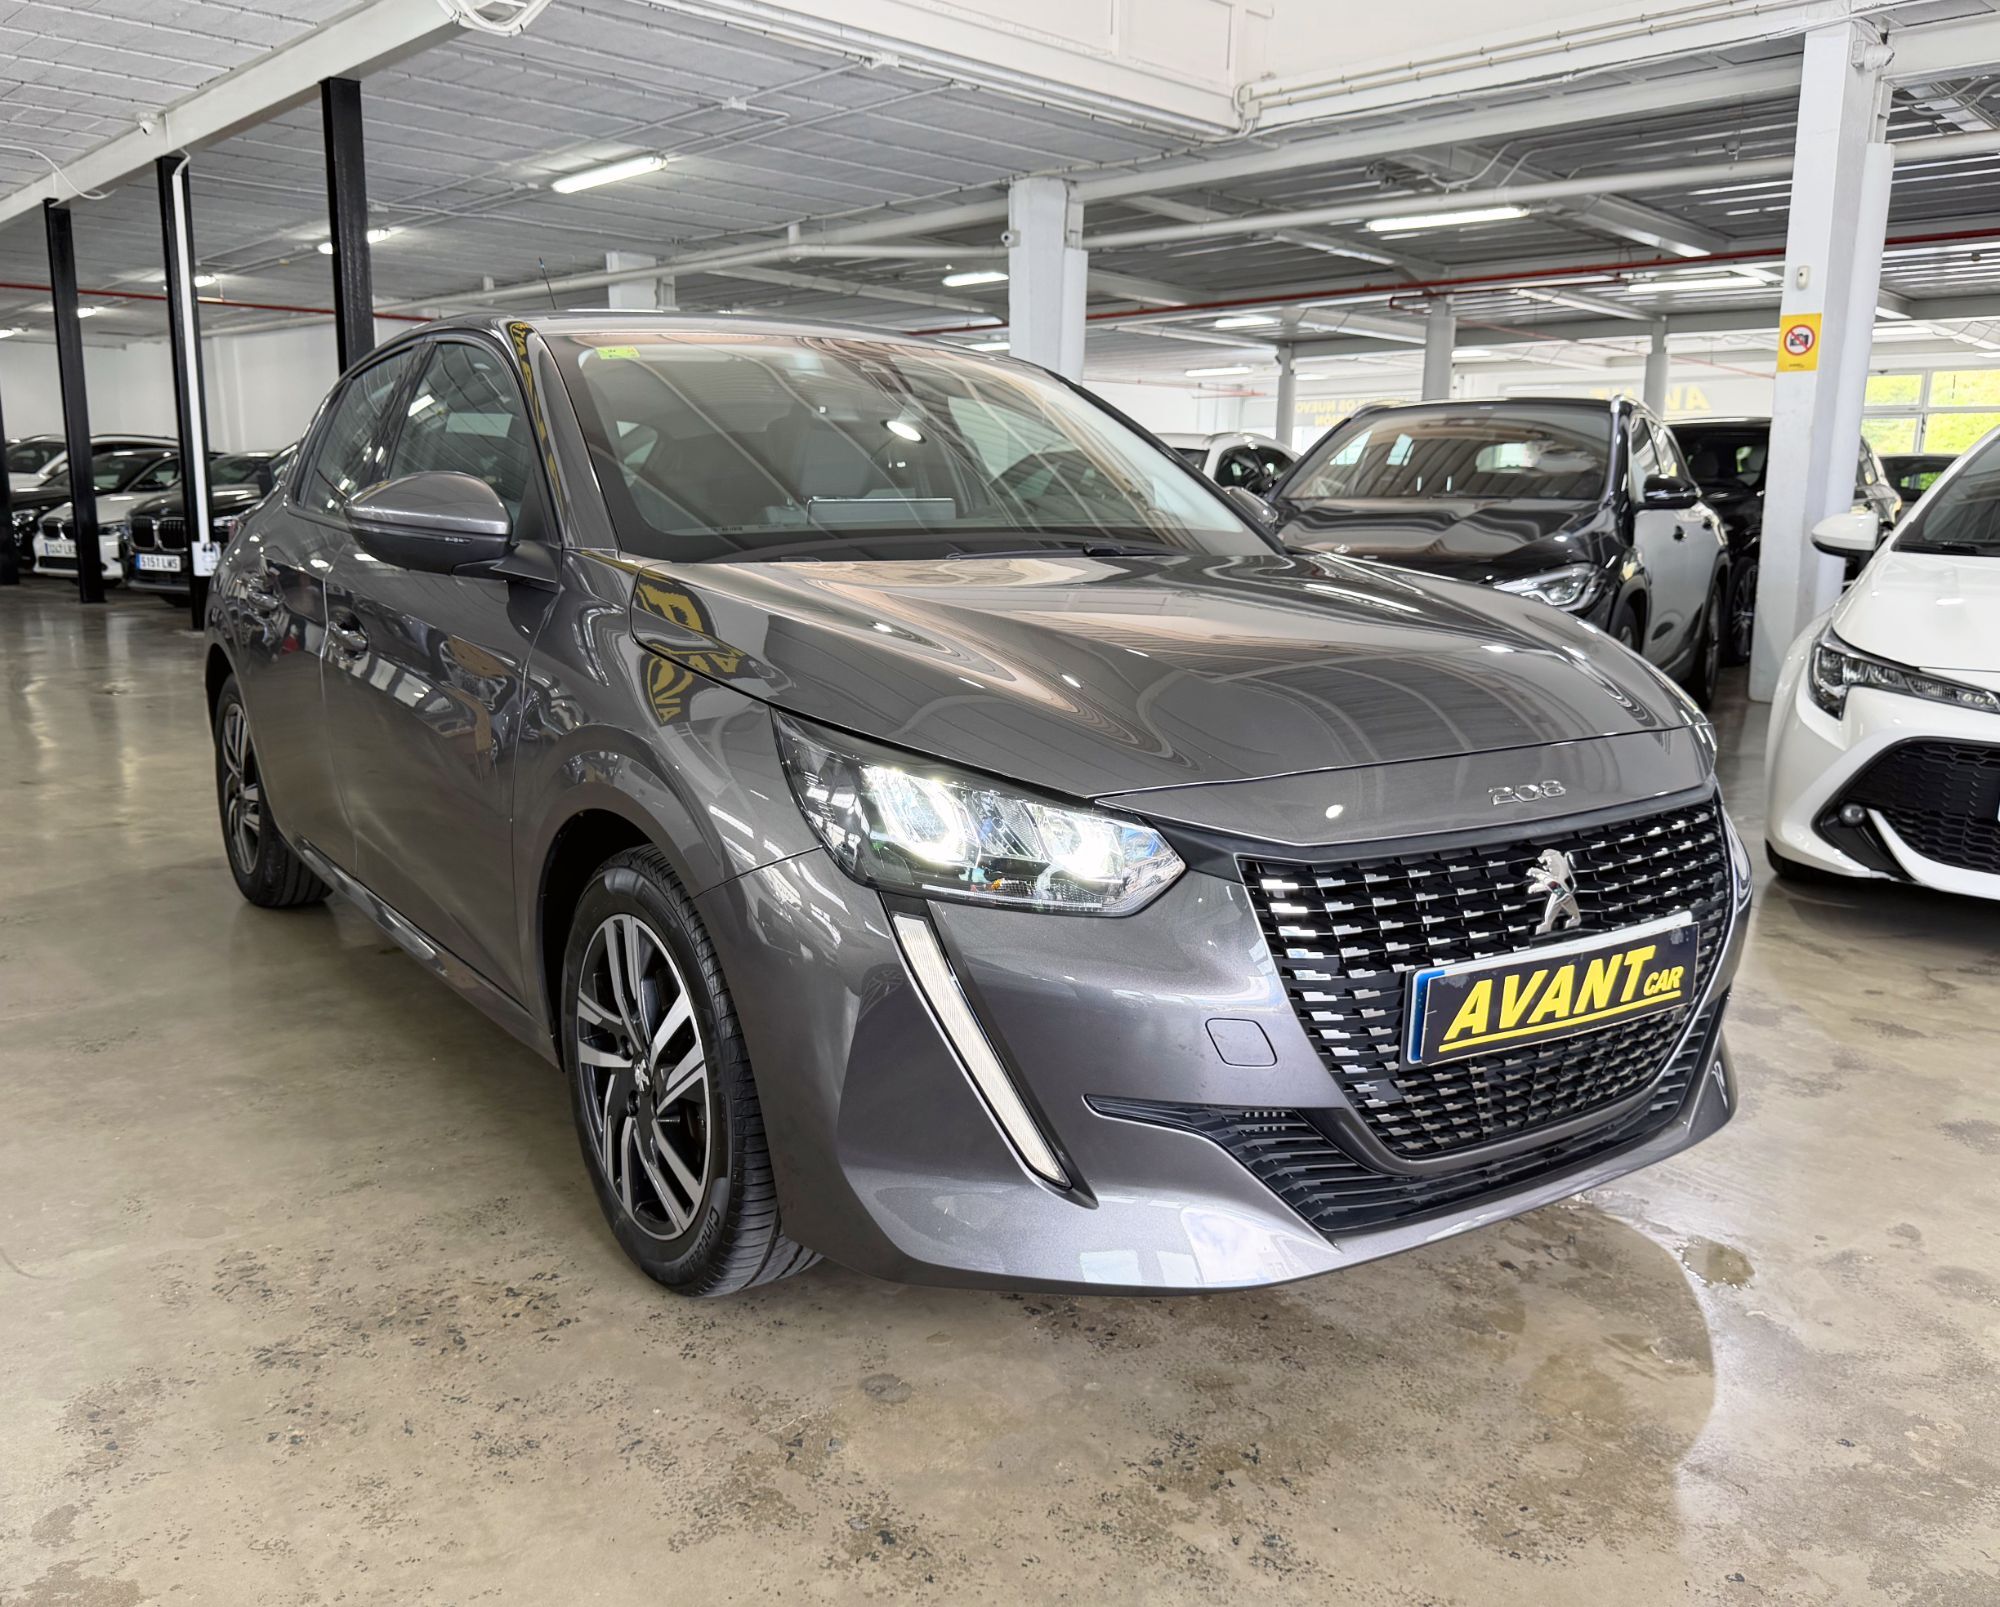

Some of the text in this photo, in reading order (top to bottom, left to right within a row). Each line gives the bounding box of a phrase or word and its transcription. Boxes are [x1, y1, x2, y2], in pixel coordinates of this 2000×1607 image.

[1488, 780, 1566, 805] 208
[1443, 945, 1685, 1040] AVANT CAR
